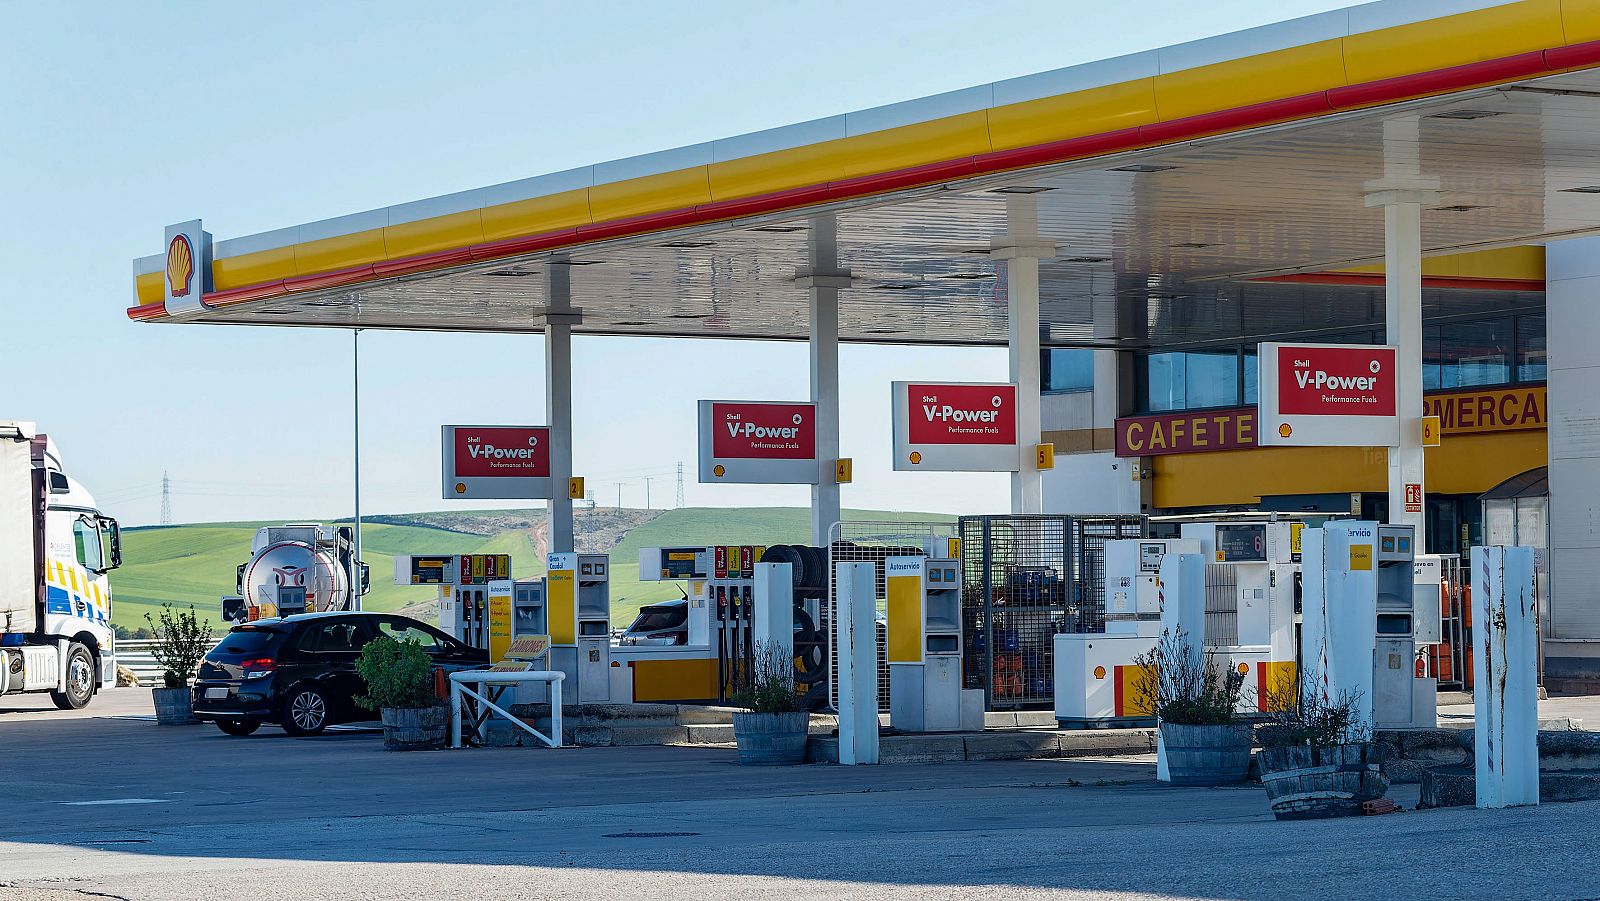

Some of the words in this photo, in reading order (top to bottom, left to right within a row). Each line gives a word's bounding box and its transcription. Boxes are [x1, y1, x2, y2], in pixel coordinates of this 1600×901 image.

[1294, 370, 1377, 390] V-Power
[1321, 394, 1361, 403] Performance
[1361, 395, 1377, 403] Fuels
[923, 405, 999, 422] V-Power
[727, 422, 799, 439] V-Power
[948, 426, 984, 434] Performance
[1126, 415, 1253, 451] CAFETE
[1424, 424, 1431, 438] 6
[467, 444, 535, 459] V-Power
[1039, 451, 1045, 464] 5
[838, 465, 844, 476] 4
[571, 483, 577, 493] 2
[1348, 528, 1371, 537] ervicio
[1254, 535, 1262, 552] 6
[889, 562, 920, 571] Autoservicio
